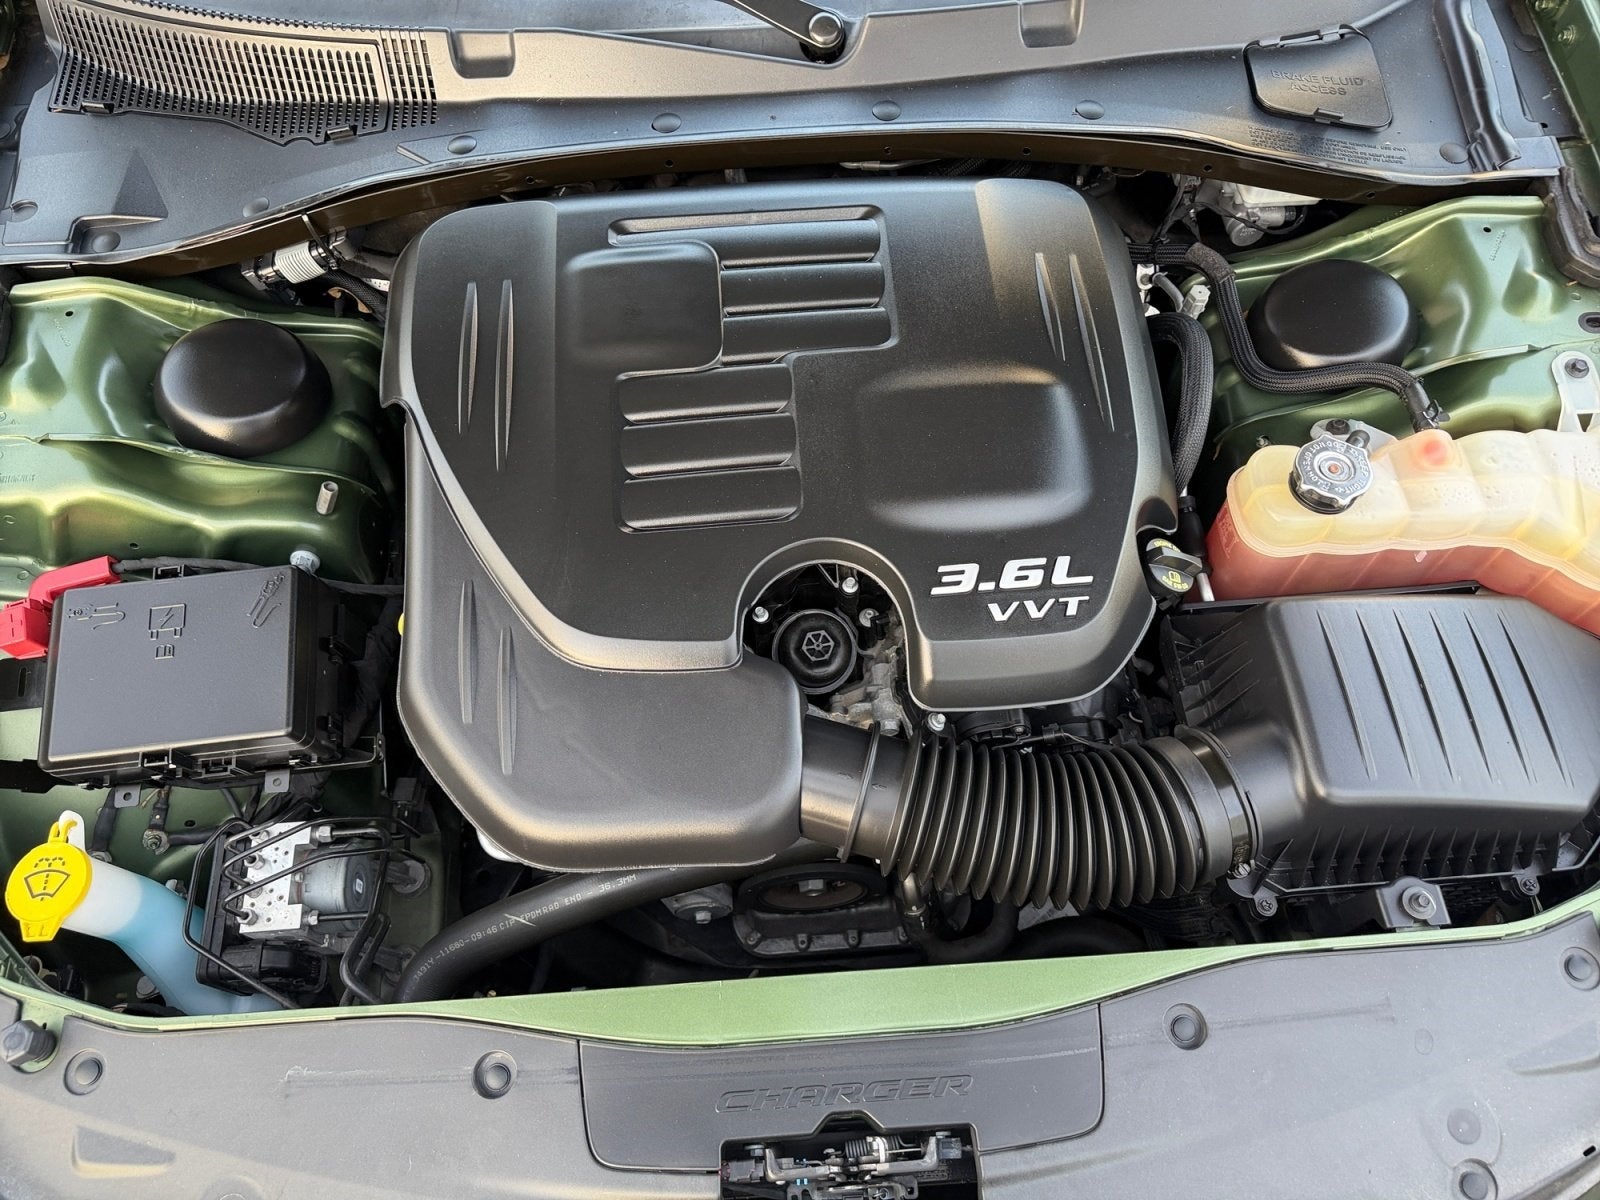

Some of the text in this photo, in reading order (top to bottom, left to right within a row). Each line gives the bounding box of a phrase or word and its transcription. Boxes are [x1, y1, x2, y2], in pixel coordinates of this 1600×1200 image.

[1271, 69, 1364, 87] BRAKE FLUID
[1290, 83, 1347, 96] ACCESS
[930, 555, 1094, 596] 3.6L
[987, 595, 1090, 622] VVT
[715, 1074, 974, 1113] CHARGER
